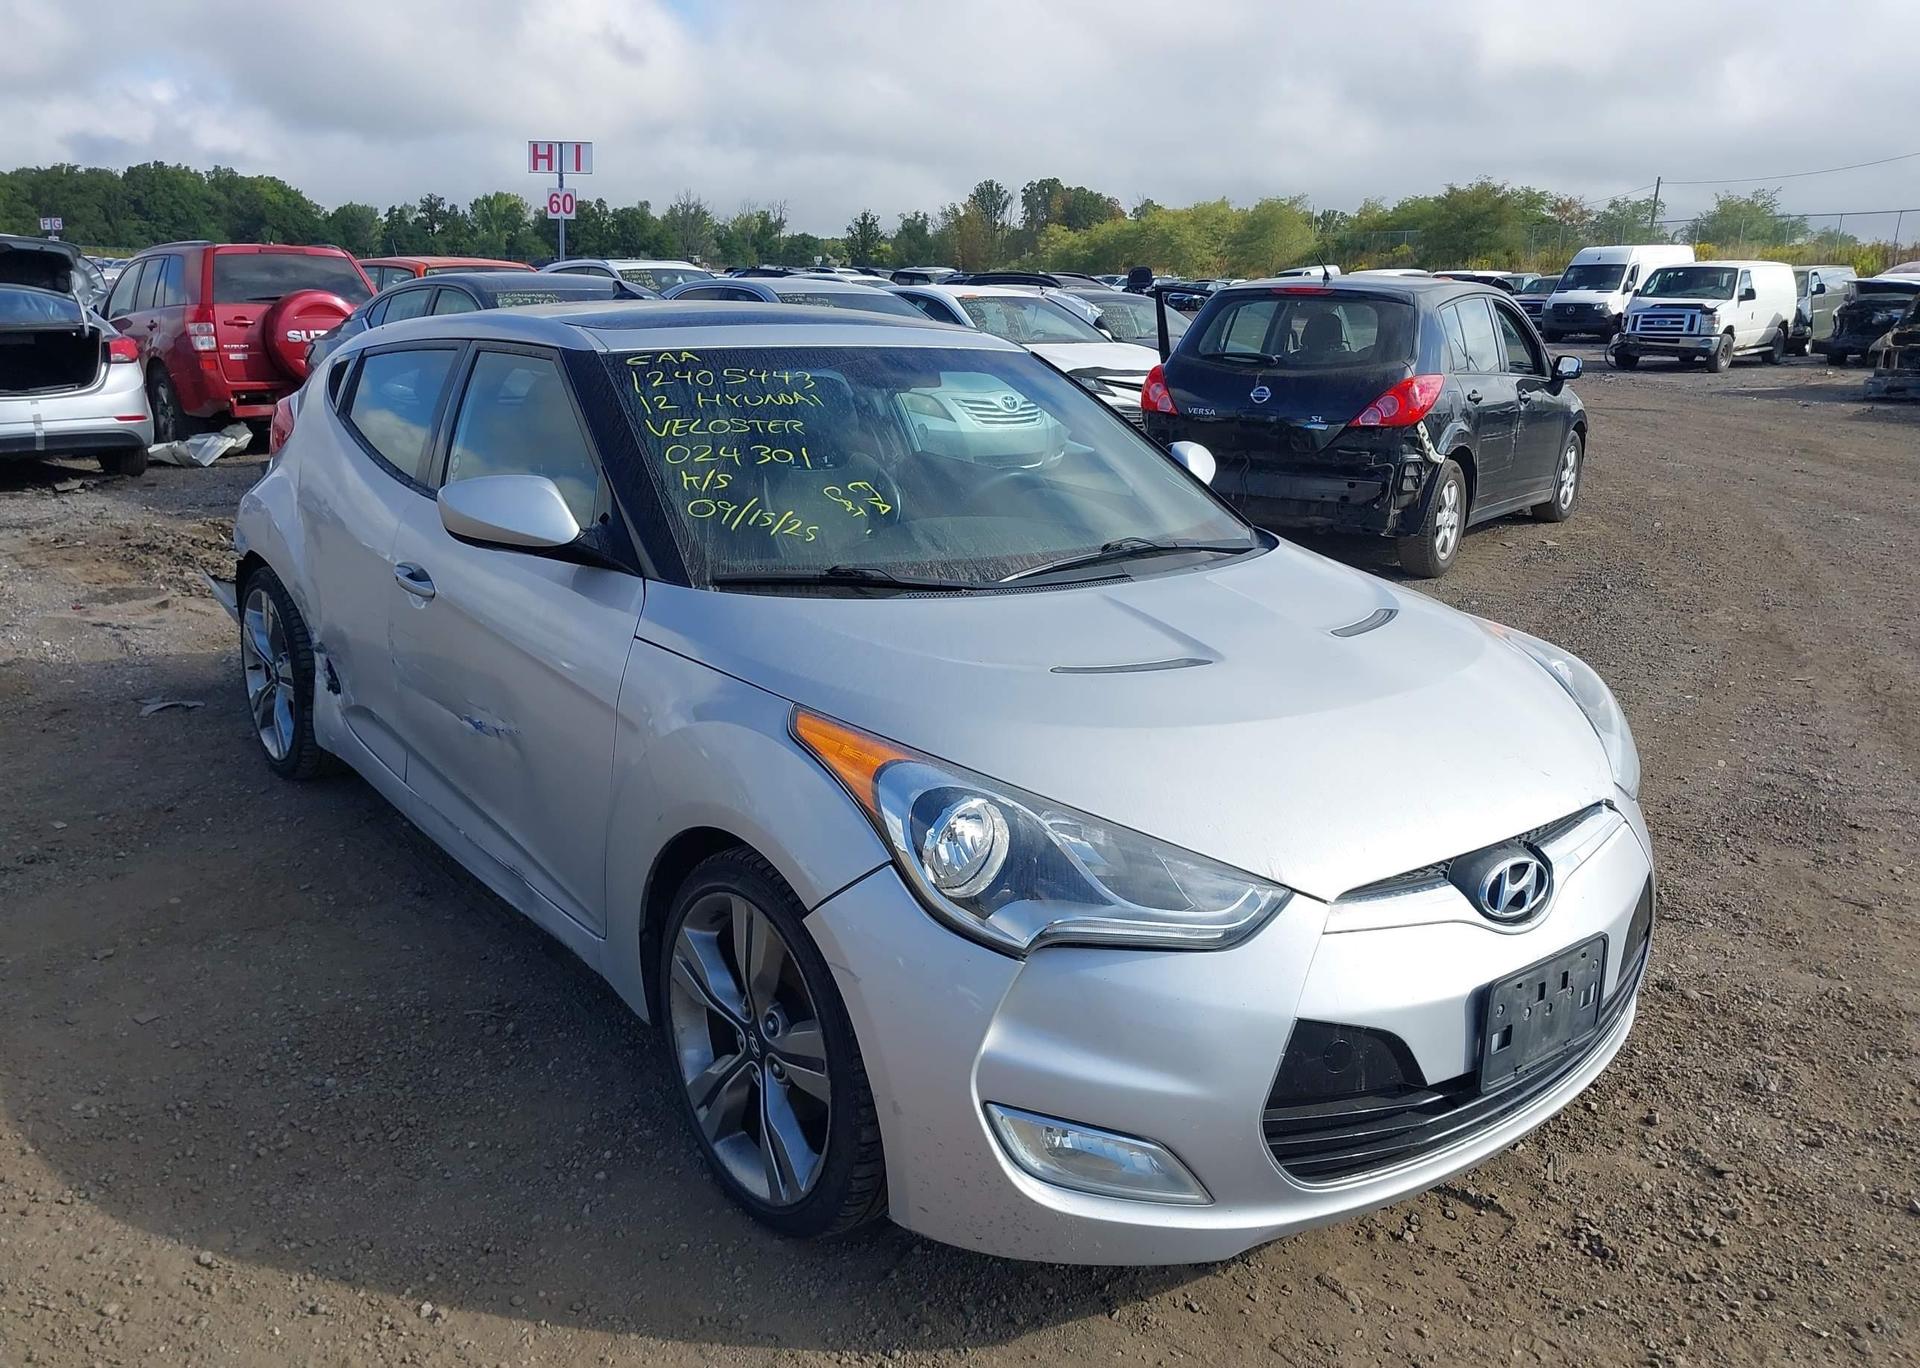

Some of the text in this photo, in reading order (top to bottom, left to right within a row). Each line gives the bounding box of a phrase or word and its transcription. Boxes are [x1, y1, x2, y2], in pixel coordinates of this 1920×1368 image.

[532, 143, 581, 172] H I
[548, 192, 574, 214] 60
[286, 329, 329, 343] SUZ
[639, 391, 825, 415] 12 HYUNDAI
[1188, 407, 1216, 416] VERSA
[645, 417, 807, 438] VELOSTER
[1310, 415, 1326, 423] SL
